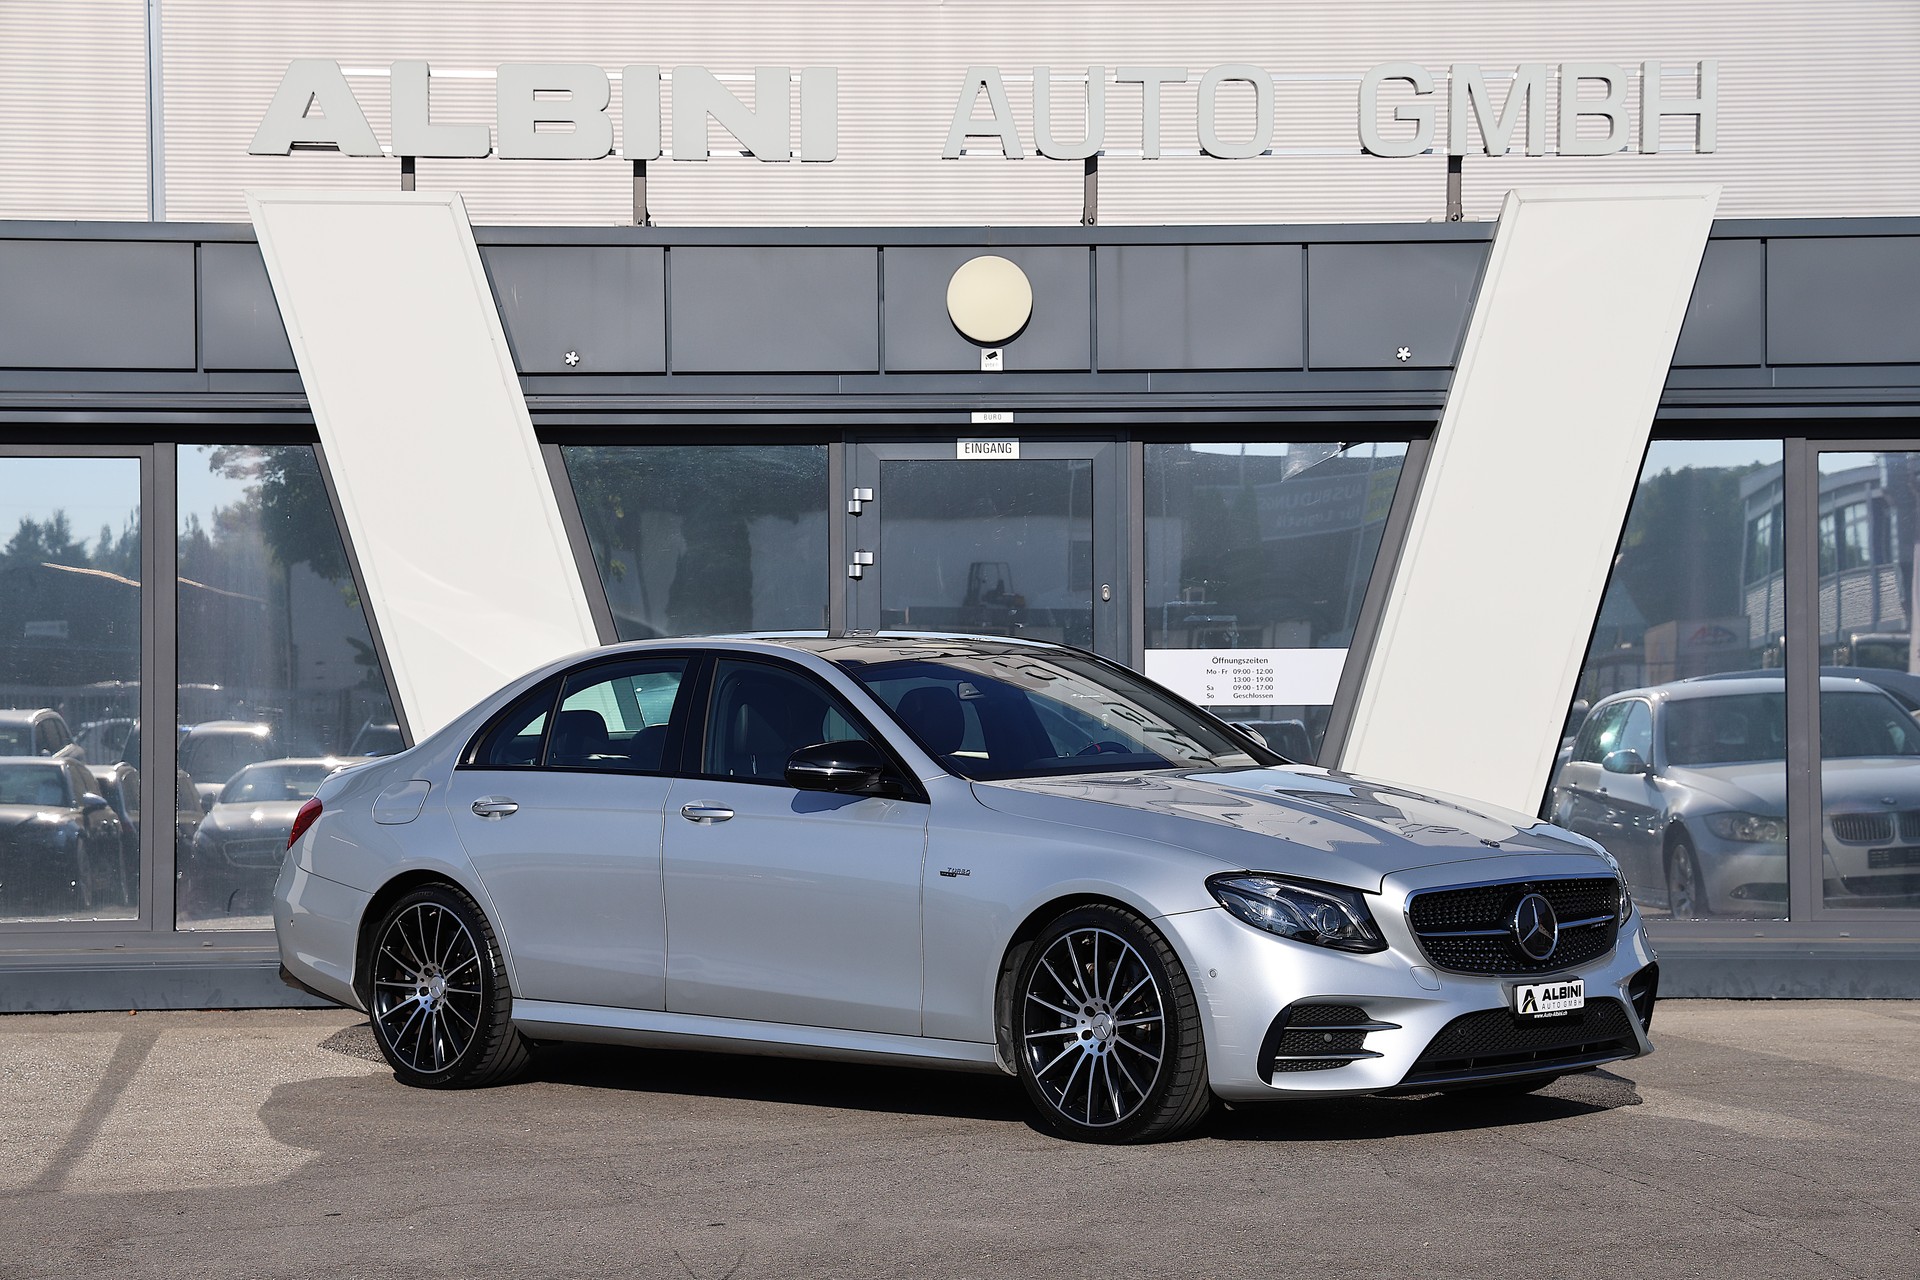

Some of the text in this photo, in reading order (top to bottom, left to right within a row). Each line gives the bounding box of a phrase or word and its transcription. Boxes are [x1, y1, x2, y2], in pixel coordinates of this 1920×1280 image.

[248, 59, 1720, 163] ALBINI AUTO GMBH
[964, 442, 1012, 454] EINGANG
[1211, 656, 1269, 665] Öffnungszeiten
[1542, 985, 1581, 1001] ALBINI
[1541, 999, 1582, 1010] AUTO GMBH
